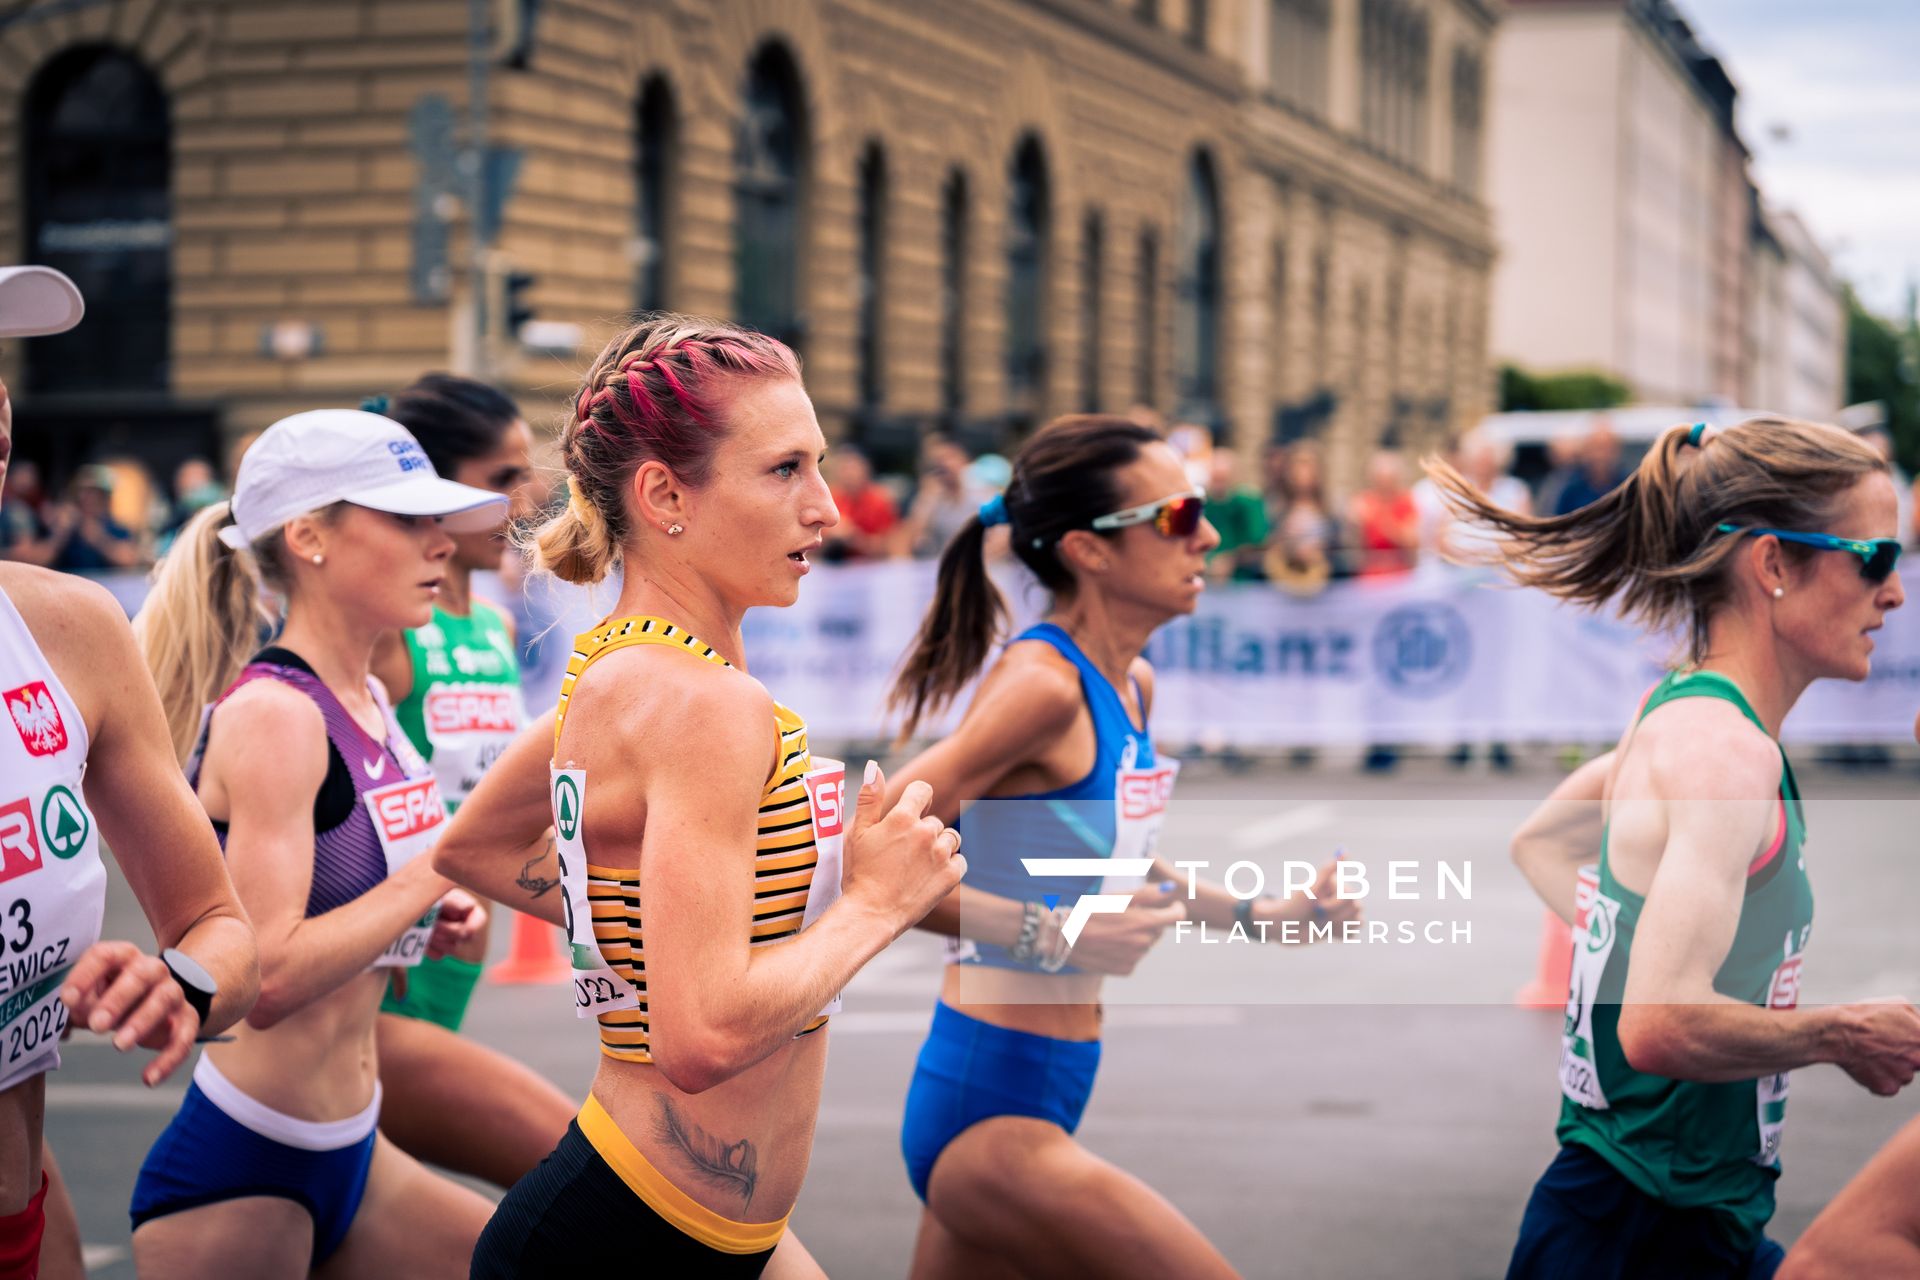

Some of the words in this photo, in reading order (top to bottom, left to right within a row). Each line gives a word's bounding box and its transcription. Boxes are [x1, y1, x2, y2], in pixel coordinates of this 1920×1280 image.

[1148, 617, 1357, 677] llianz
[379, 783, 443, 836] SPA
[575, 976, 625, 1008] 022
[8, 997, 66, 1063] 2022
